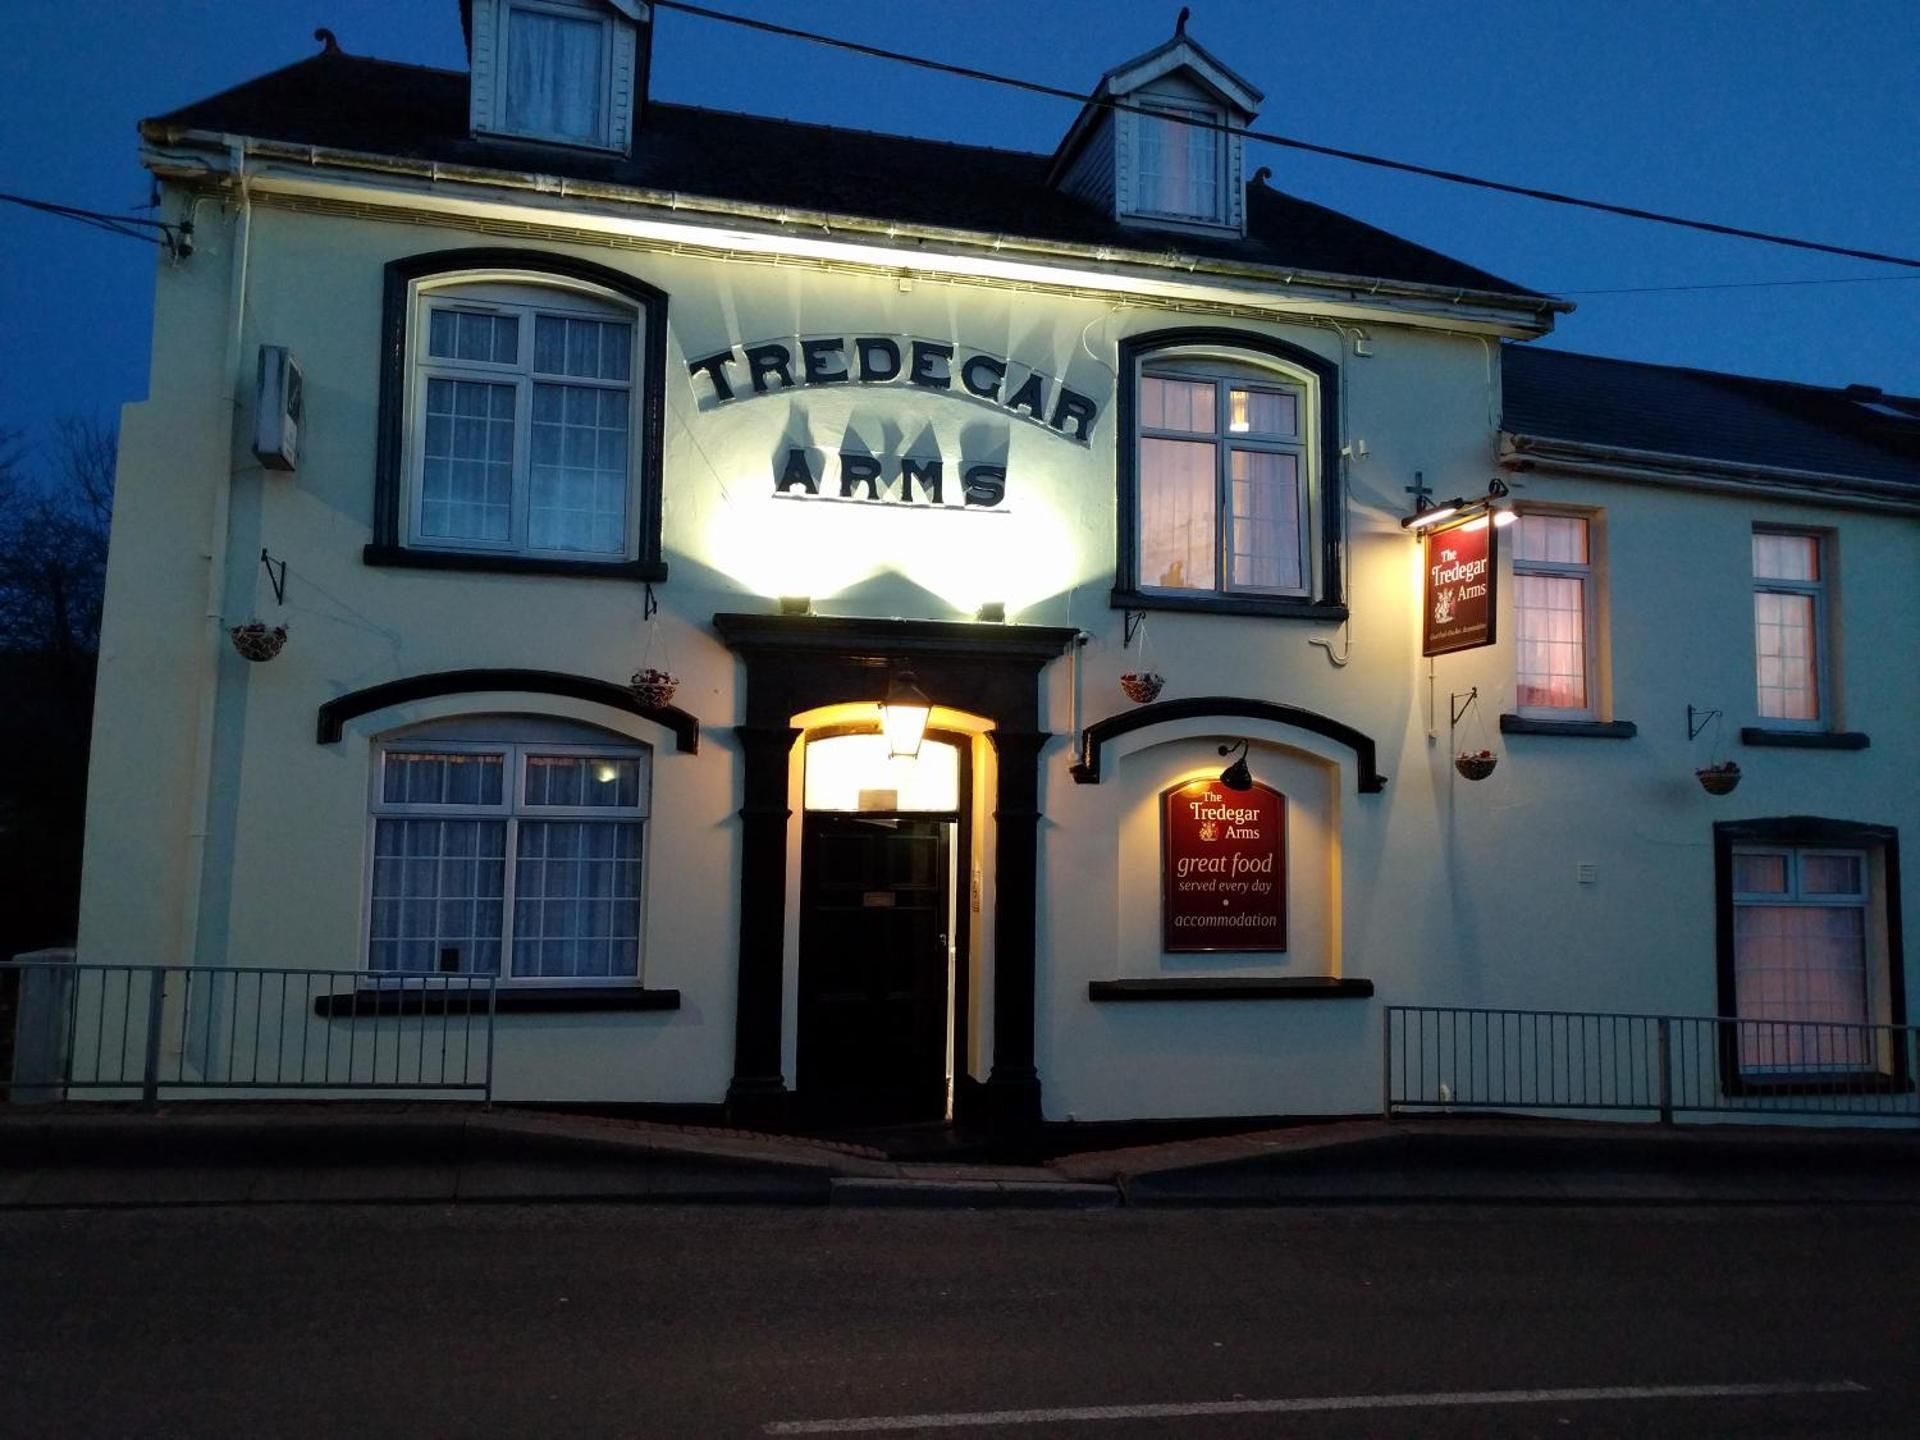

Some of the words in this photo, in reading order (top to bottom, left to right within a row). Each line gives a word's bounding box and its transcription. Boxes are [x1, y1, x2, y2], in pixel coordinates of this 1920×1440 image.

[689, 337, 1098, 441] TREDEGAR
[776, 449, 1007, 506] ARMS
[1441, 550, 1457, 563] The
[1432, 558, 1487, 586] Tredegar
[1458, 583, 1486, 601] Arms
[1203, 791, 1222, 802] The
[1190, 802, 1260, 824] Tredegar
[1225, 825, 1260, 840] Arms
[1177, 857, 1227, 877] great
[1231, 852, 1273, 878] food
[1178, 879, 1217, 892] served
[1218, 881, 1249, 894] every
[1251, 879, 1272, 894] day
[1175, 912, 1277, 927] accommodation
